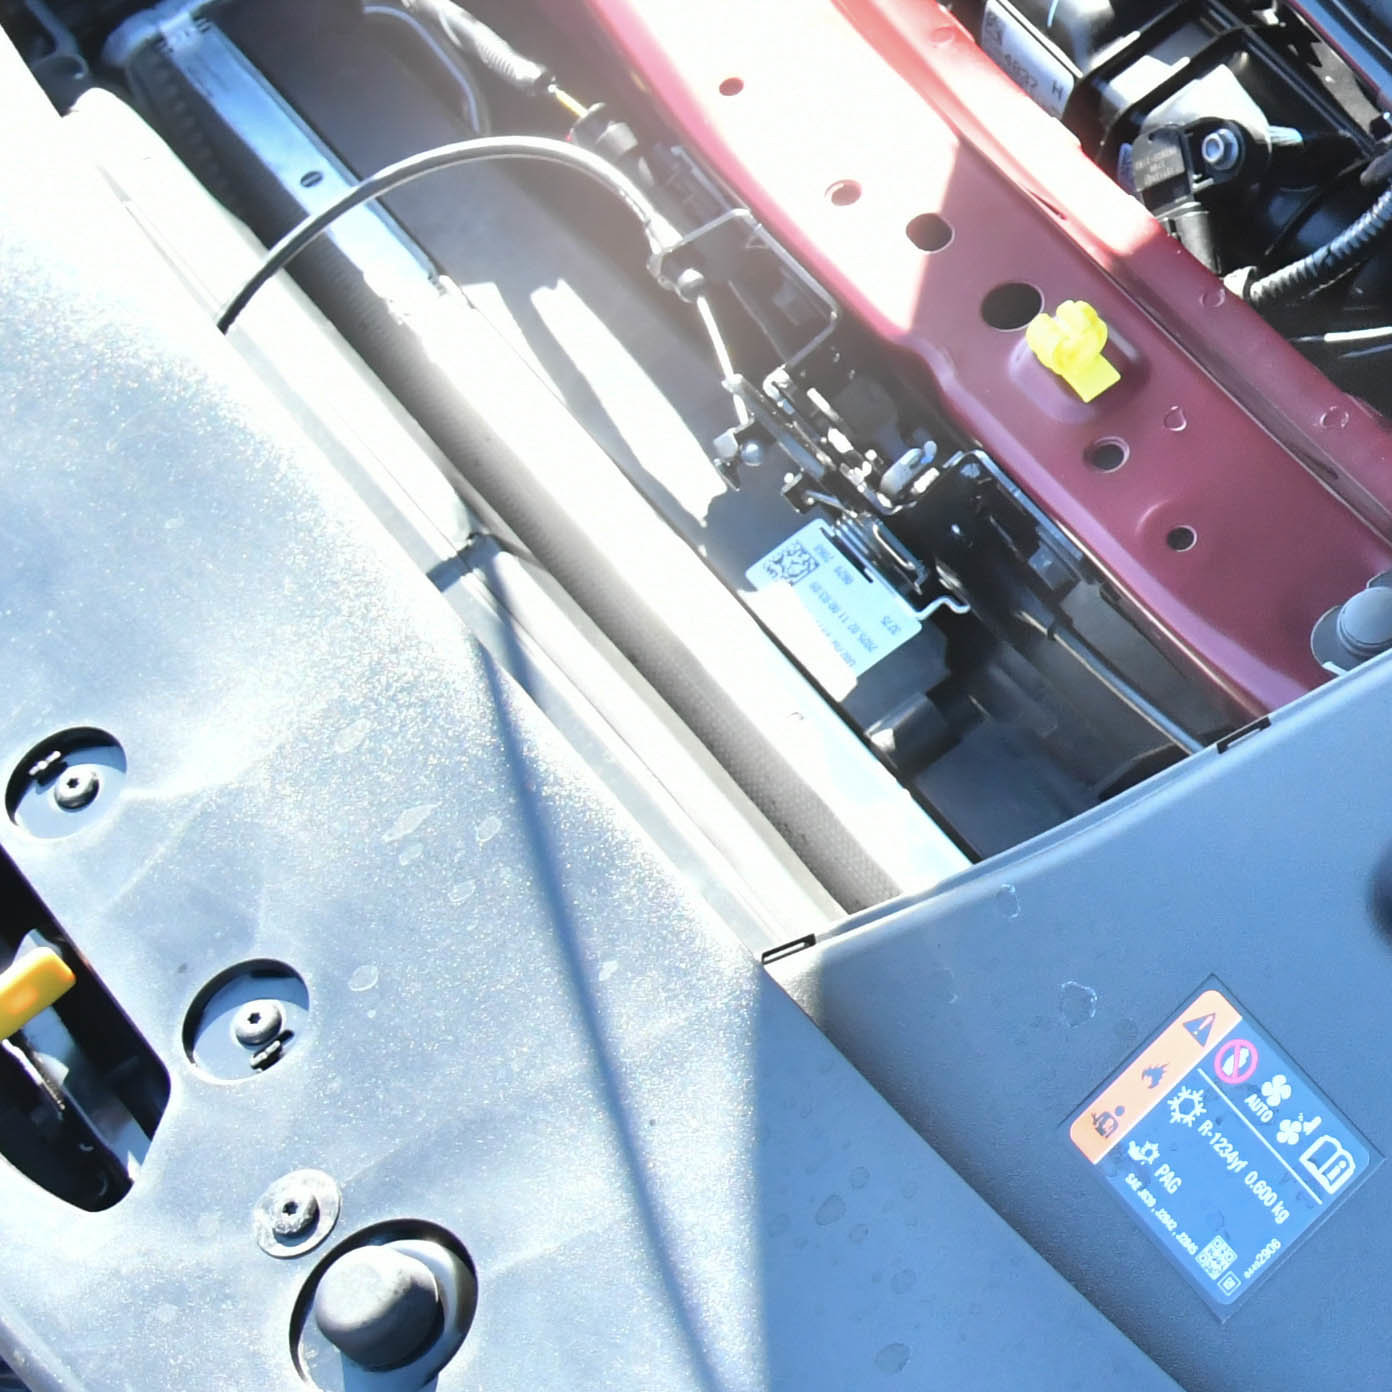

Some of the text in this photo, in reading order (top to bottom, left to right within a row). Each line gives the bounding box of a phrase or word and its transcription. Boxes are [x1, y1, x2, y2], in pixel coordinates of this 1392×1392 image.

[1244, 1094, 1273, 1123] AUTO
[1154, 1164, 1182, 1194] PAG
[1198, 1119, 1290, 1225] R-1234yf 0.600 kg
